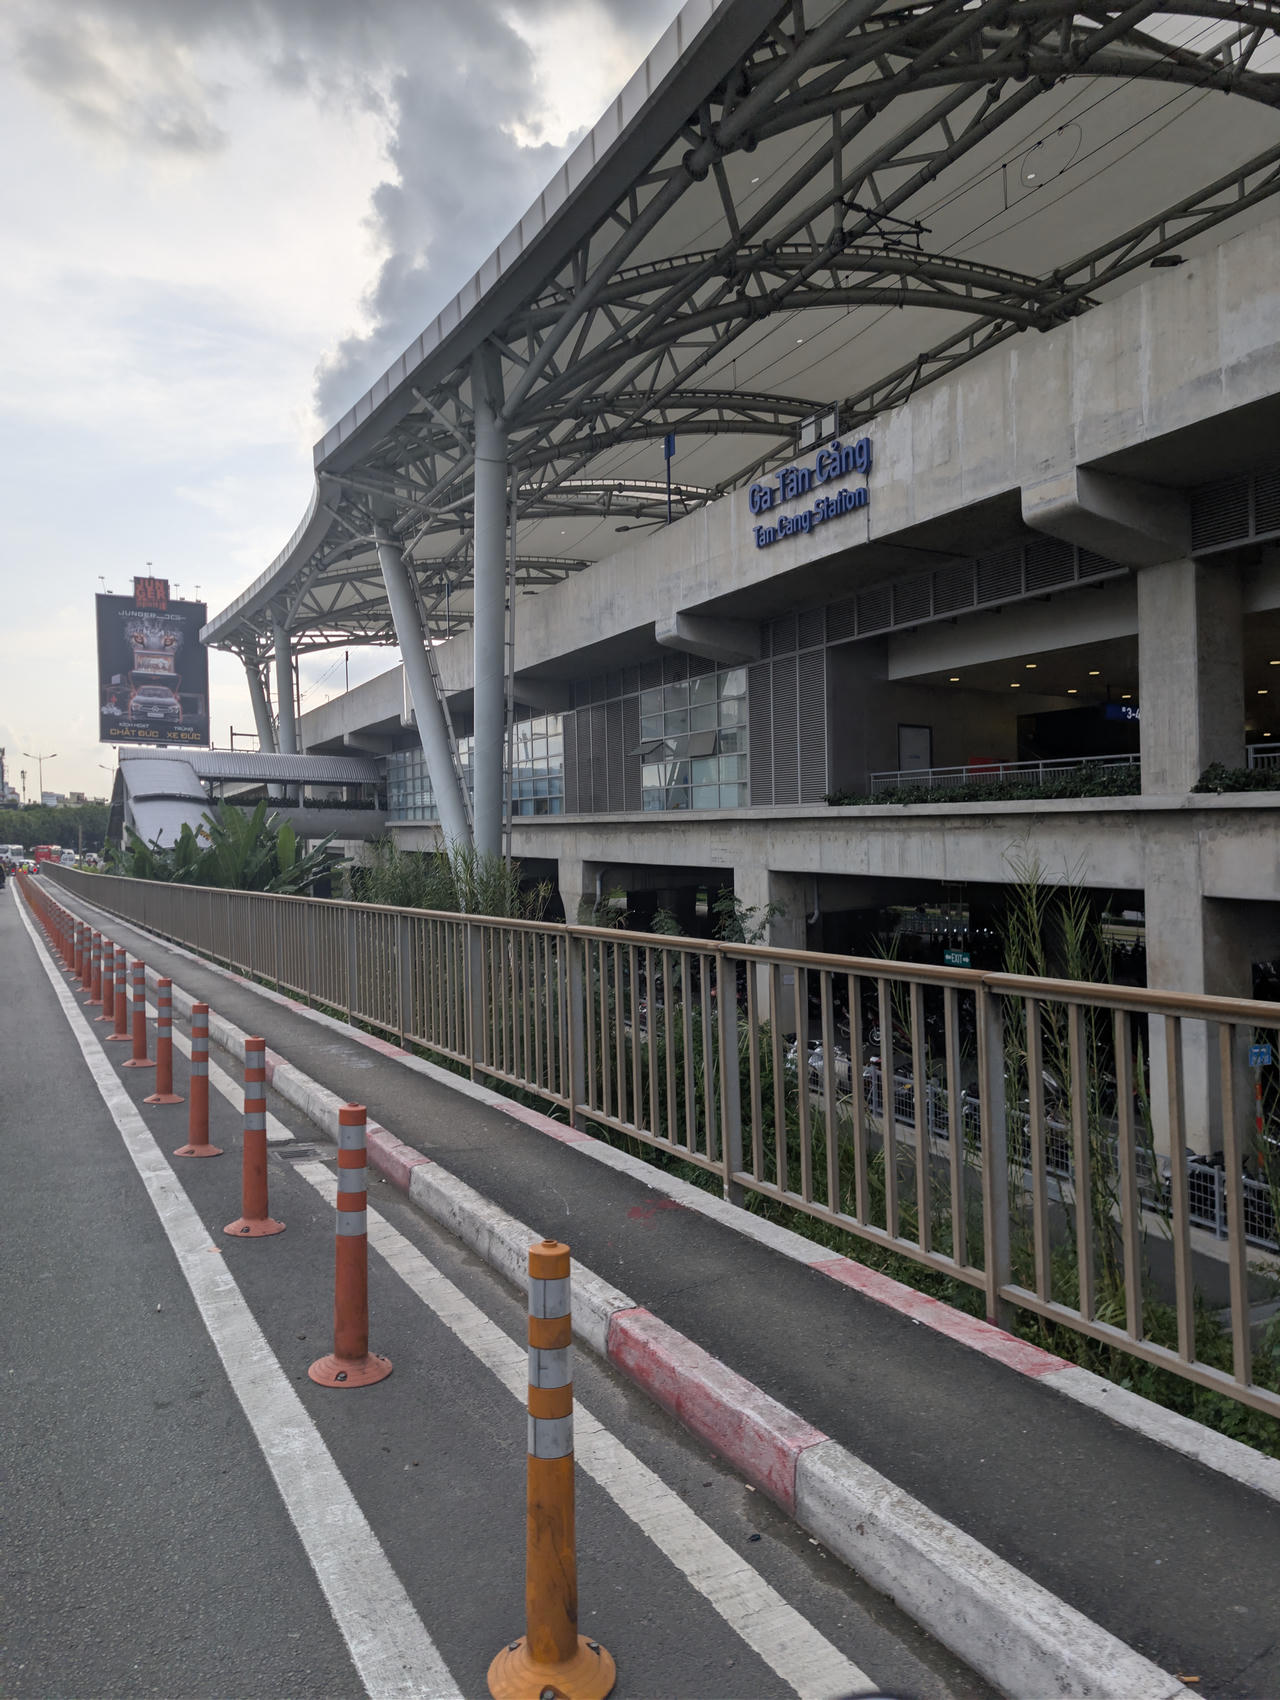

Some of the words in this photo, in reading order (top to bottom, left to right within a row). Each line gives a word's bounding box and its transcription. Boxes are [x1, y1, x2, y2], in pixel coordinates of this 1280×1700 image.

[749, 484, 773, 514] Ga
[775, 466, 811, 502] Tân
[816, 437, 872, 483] Cảng
[753, 524, 776, 548] Tan
[777, 510, 813, 538] Cang
[814, 487, 869, 522] Station
[952, 951, 962, 963] EXIT
